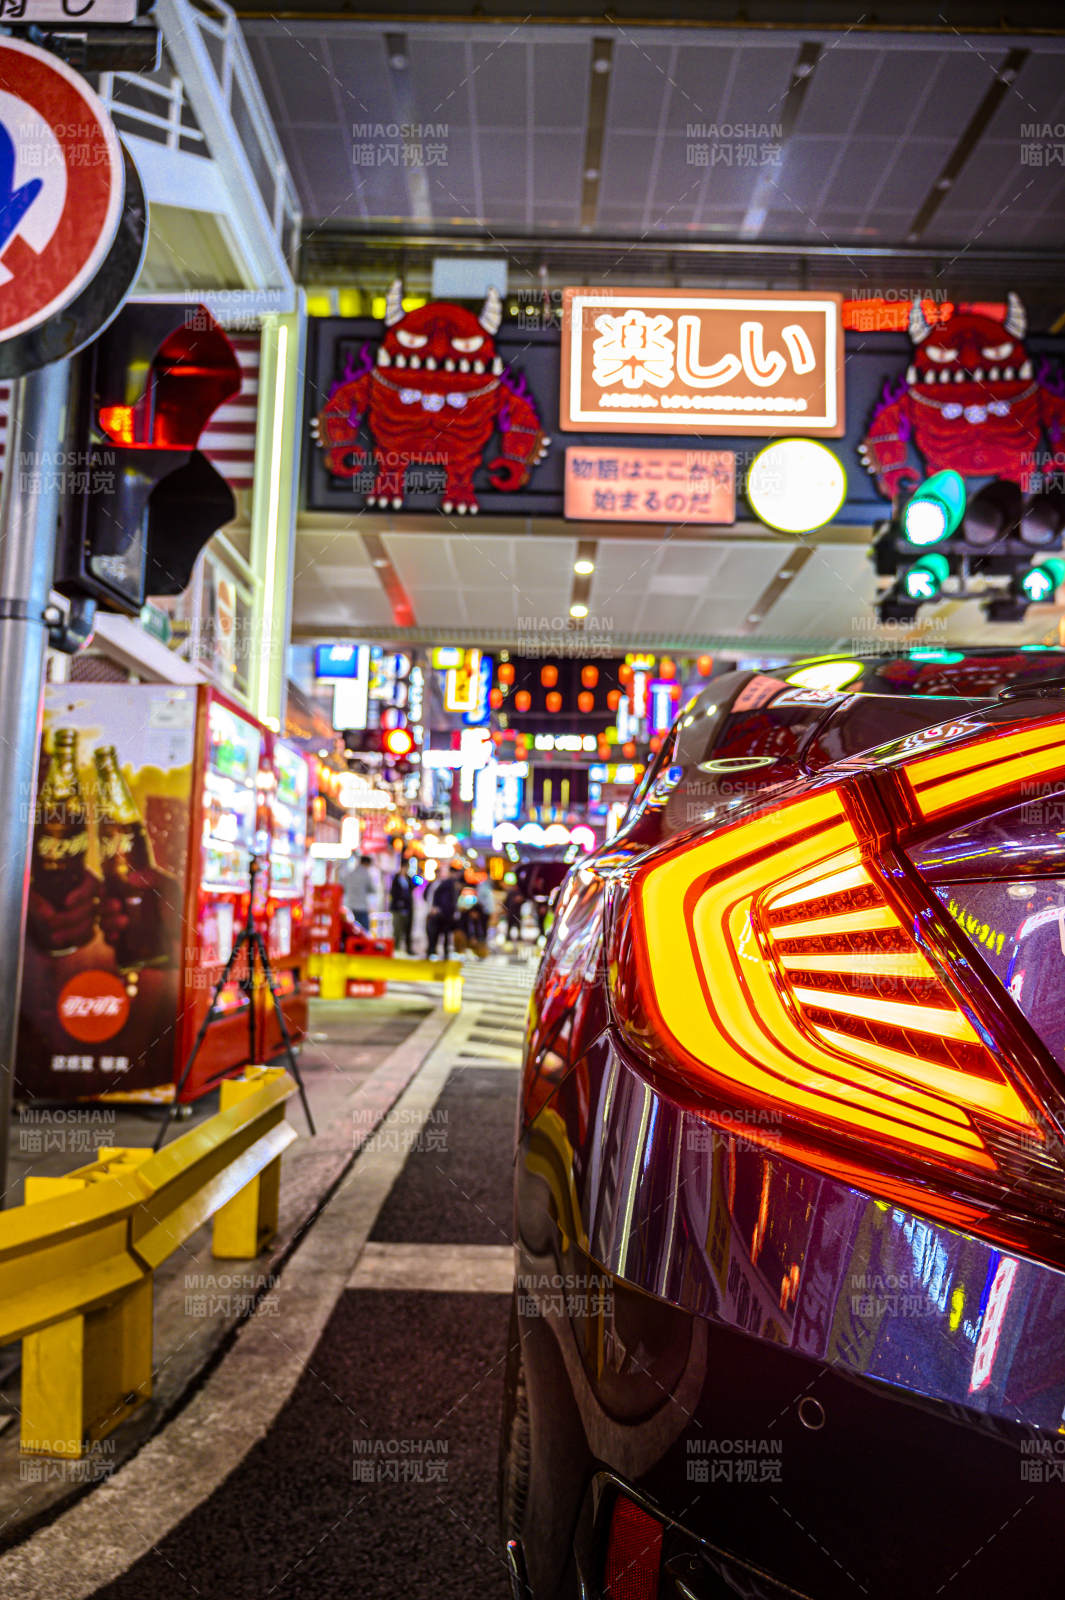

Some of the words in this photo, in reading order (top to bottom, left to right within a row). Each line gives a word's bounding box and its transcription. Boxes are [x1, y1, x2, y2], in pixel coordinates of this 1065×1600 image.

[592, 310, 816, 389] 楽しい
[592, 490, 713, 513] 始まるのだ
